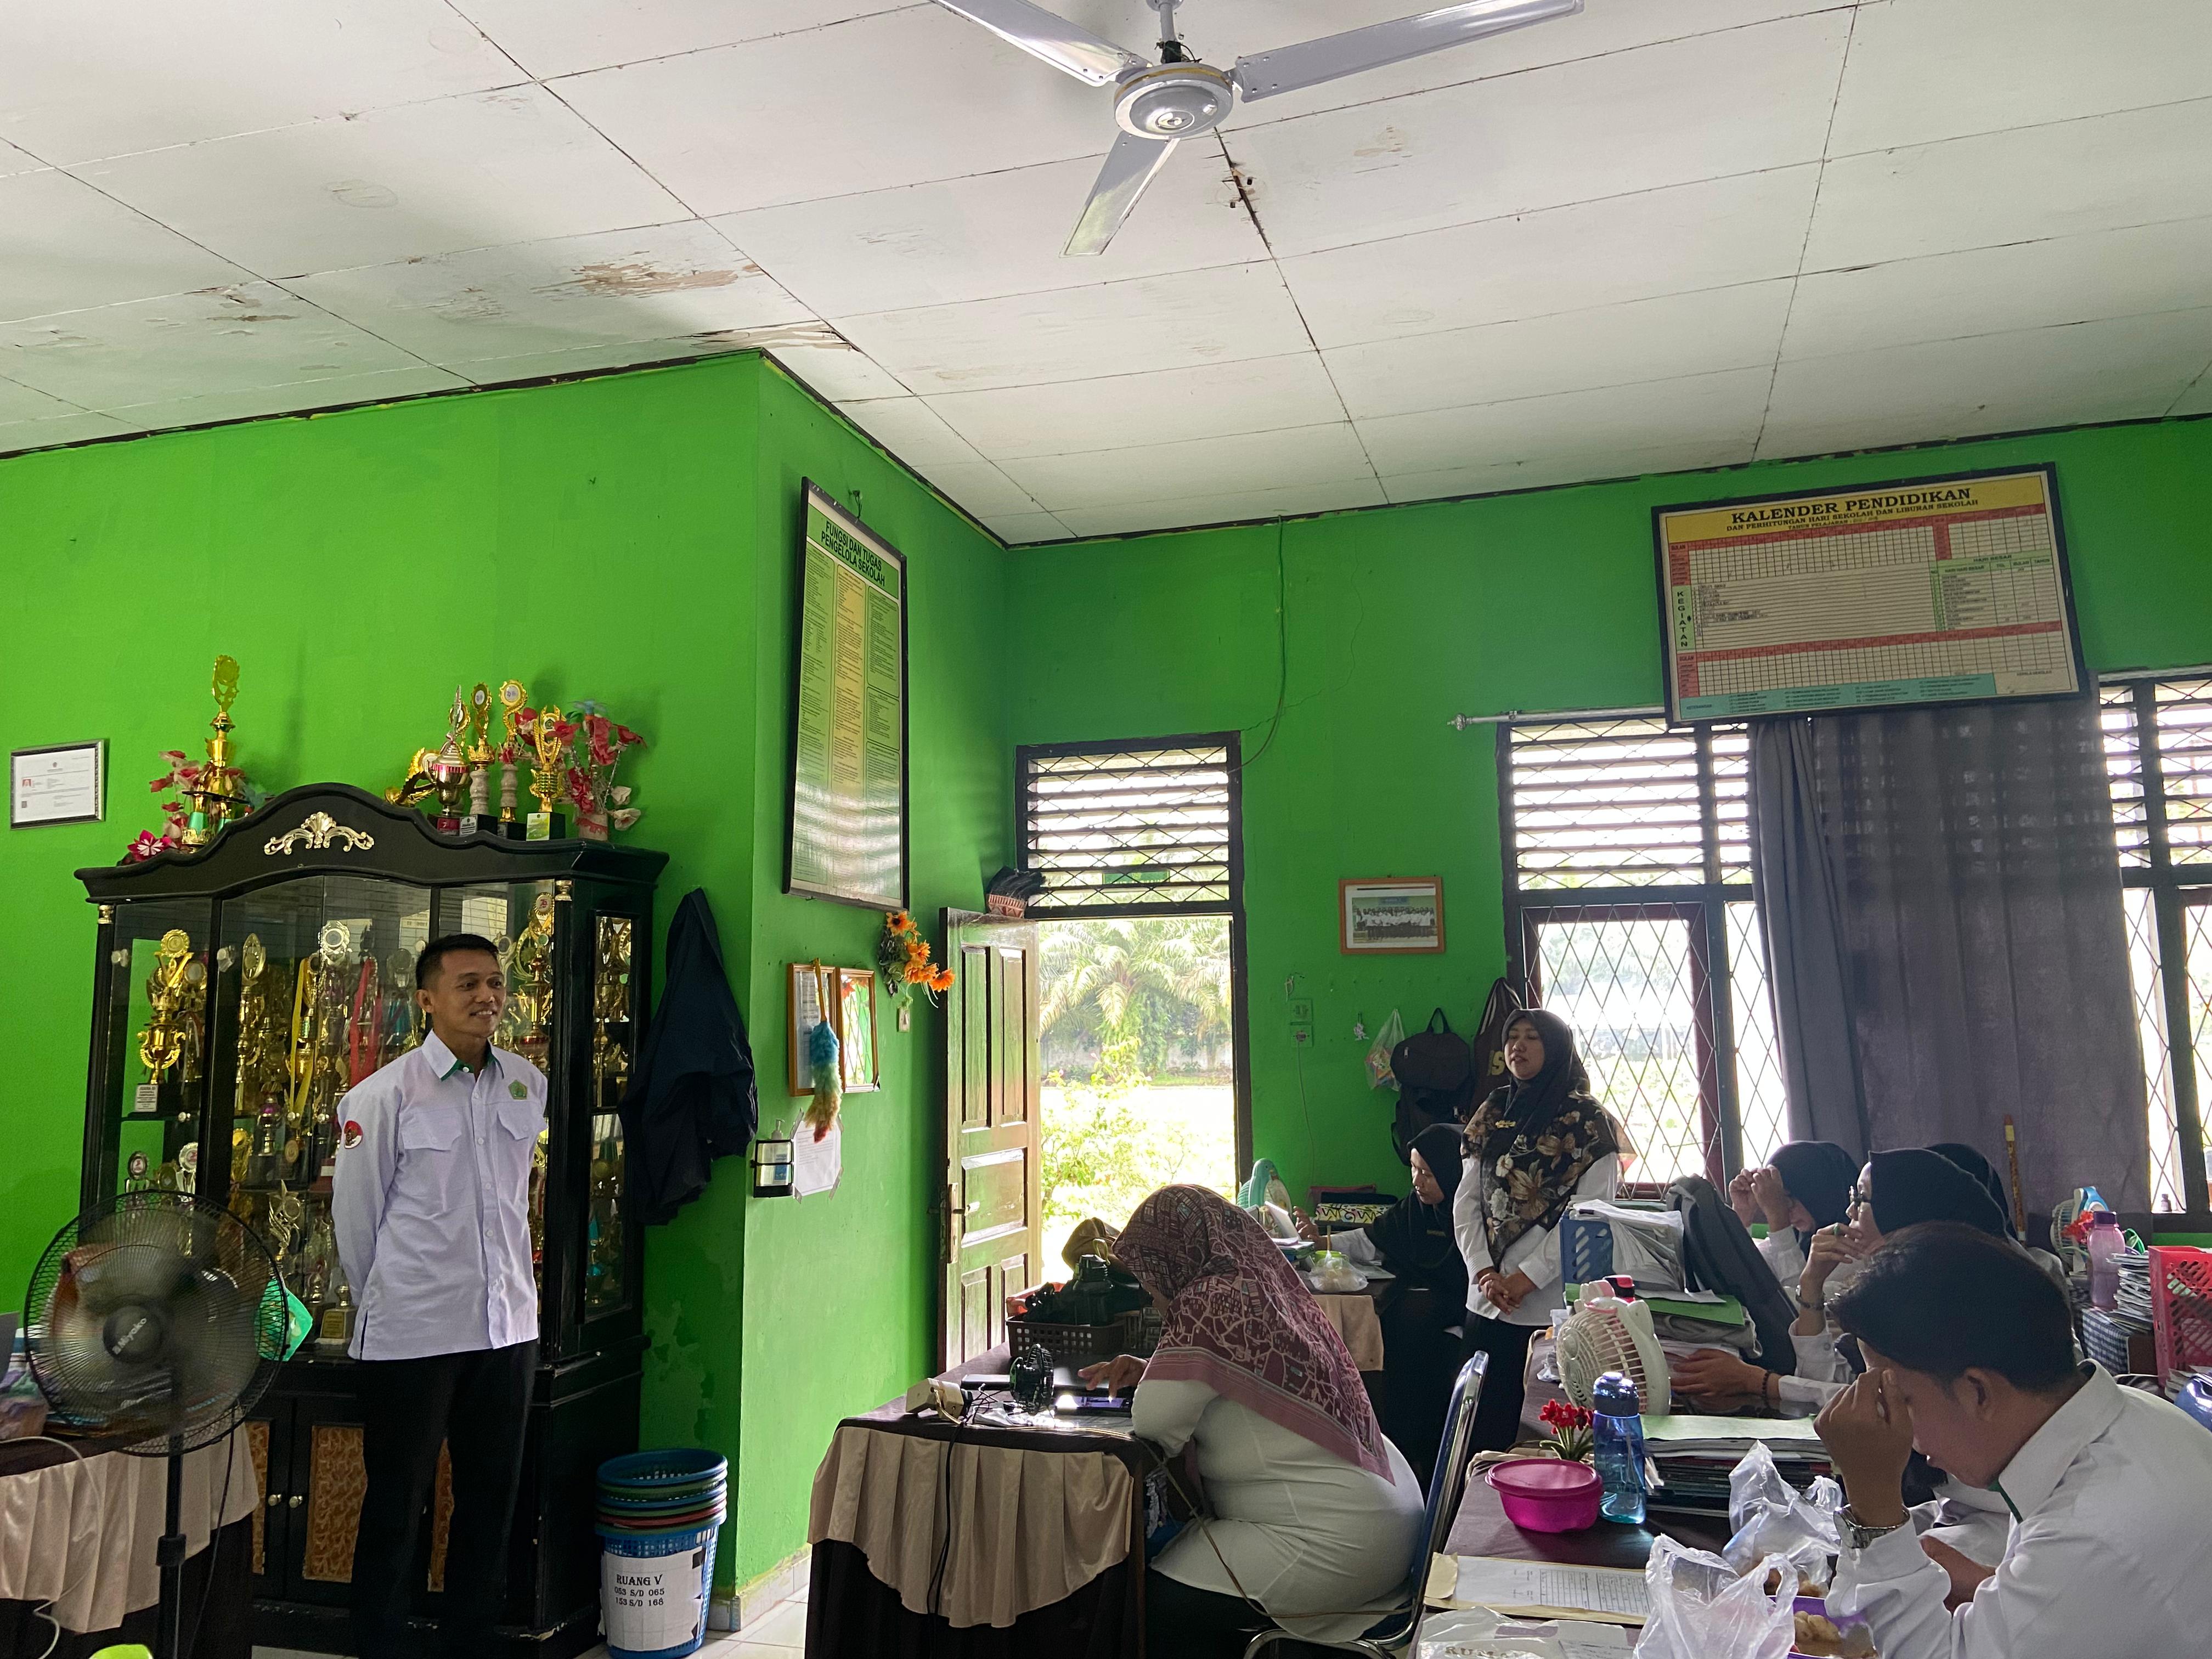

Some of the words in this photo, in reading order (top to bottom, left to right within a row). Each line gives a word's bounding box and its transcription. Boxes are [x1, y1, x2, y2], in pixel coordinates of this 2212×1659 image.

[1731, 503, 1839, 523] KALENDER
[1845, 488, 1971, 511] PENDIDIKAN
[1746, 518, 1805, 529] PERHITUNGAN
[1809, 515, 1830, 523] HARI
[1832, 511, 1873, 520] SEKOLAH
[1896, 504, 1933, 514] LIBURAN
[1937, 500, 1978, 509] SEKOLAH
[821, 531, 857, 567] PENGELOLA
[858, 558, 885, 586] SEKOLAH
[826, 521, 848, 547] FUNGSI
[850, 539, 861, 557] DAN
[863, 548, 882, 572] TUGAS
[118, 1318, 147, 1348] Miyako
[614, 1587, 627, 1595] 053
[648, 1588, 664, 1596] 065
[617, 1574, 651, 1585] RUANG
[654, 1574, 663, 1585] V
[616, 1597, 627, 1605] 153
[649, 1598, 664, 1606] 168
